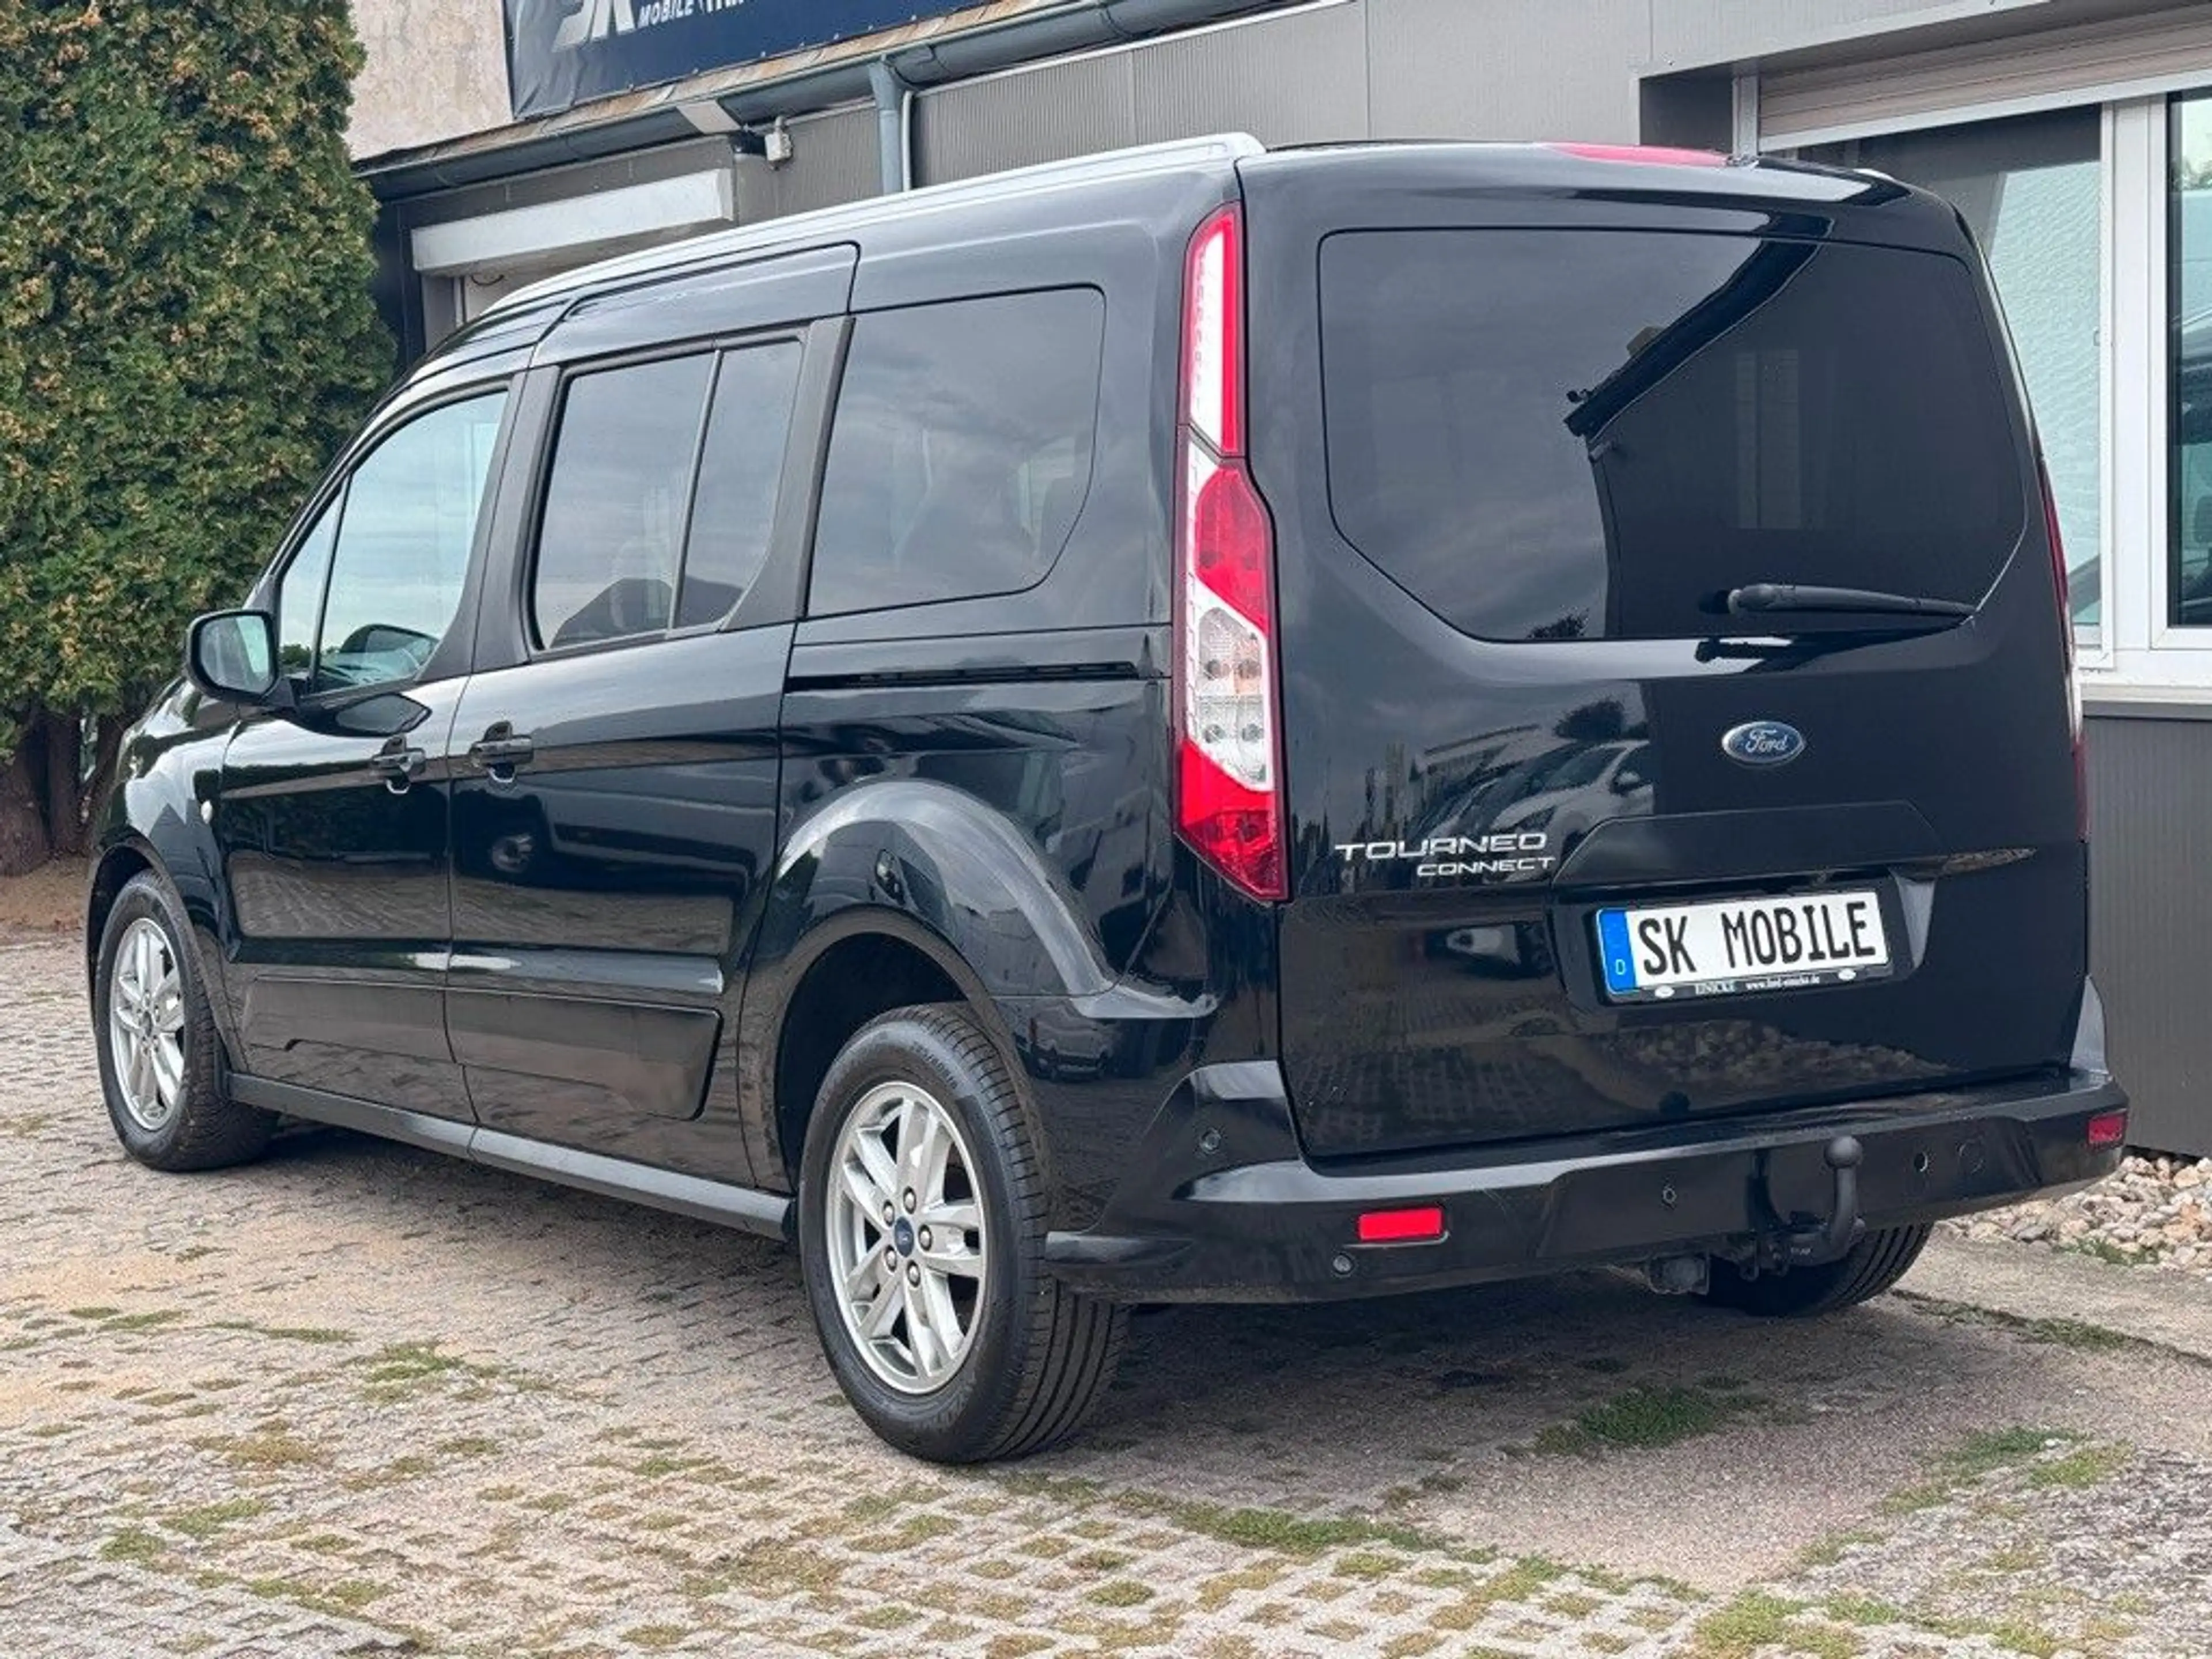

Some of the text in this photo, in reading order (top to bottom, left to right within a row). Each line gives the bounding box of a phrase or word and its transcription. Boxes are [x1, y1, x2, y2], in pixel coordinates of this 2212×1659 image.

[637, 0, 693, 28] MOBILE
[1745, 728, 1789, 753] Ford
[1334, 833, 1548, 861] TOURNEO
[1416, 857, 1556, 877] CONNECT
[1638, 901, 1876, 976] SK MOBILE
